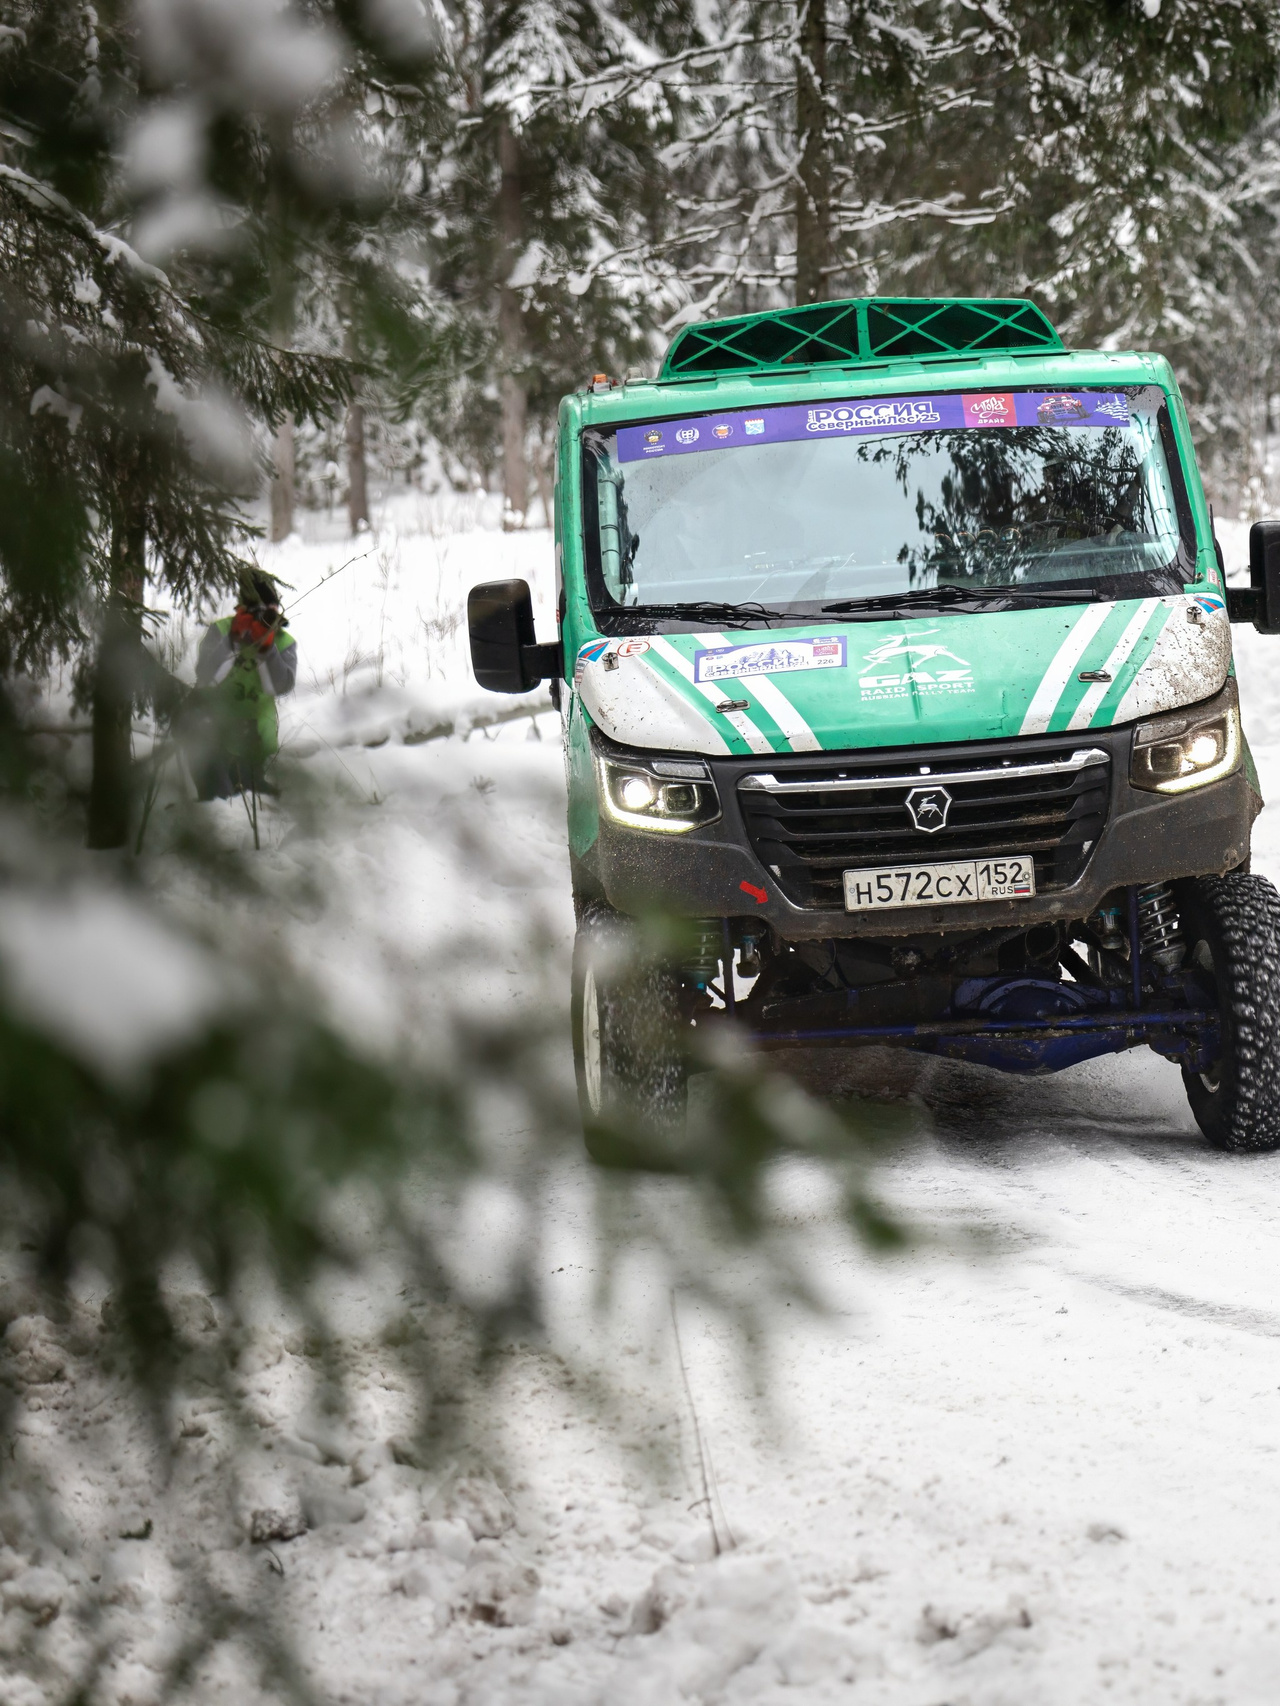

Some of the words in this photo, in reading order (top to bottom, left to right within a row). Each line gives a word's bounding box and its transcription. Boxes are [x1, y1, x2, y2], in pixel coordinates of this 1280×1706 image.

[814, 401, 933, 422] РОССИЯ
[858, 669, 974, 689] GAZ
[860, 686, 906, 696] RAID
[916, 681, 974, 691] SPORT
[860, 693, 909, 702] RUSSIAN
[979, 861, 1024, 886] 152
[991, 885, 1014, 896] RUS
